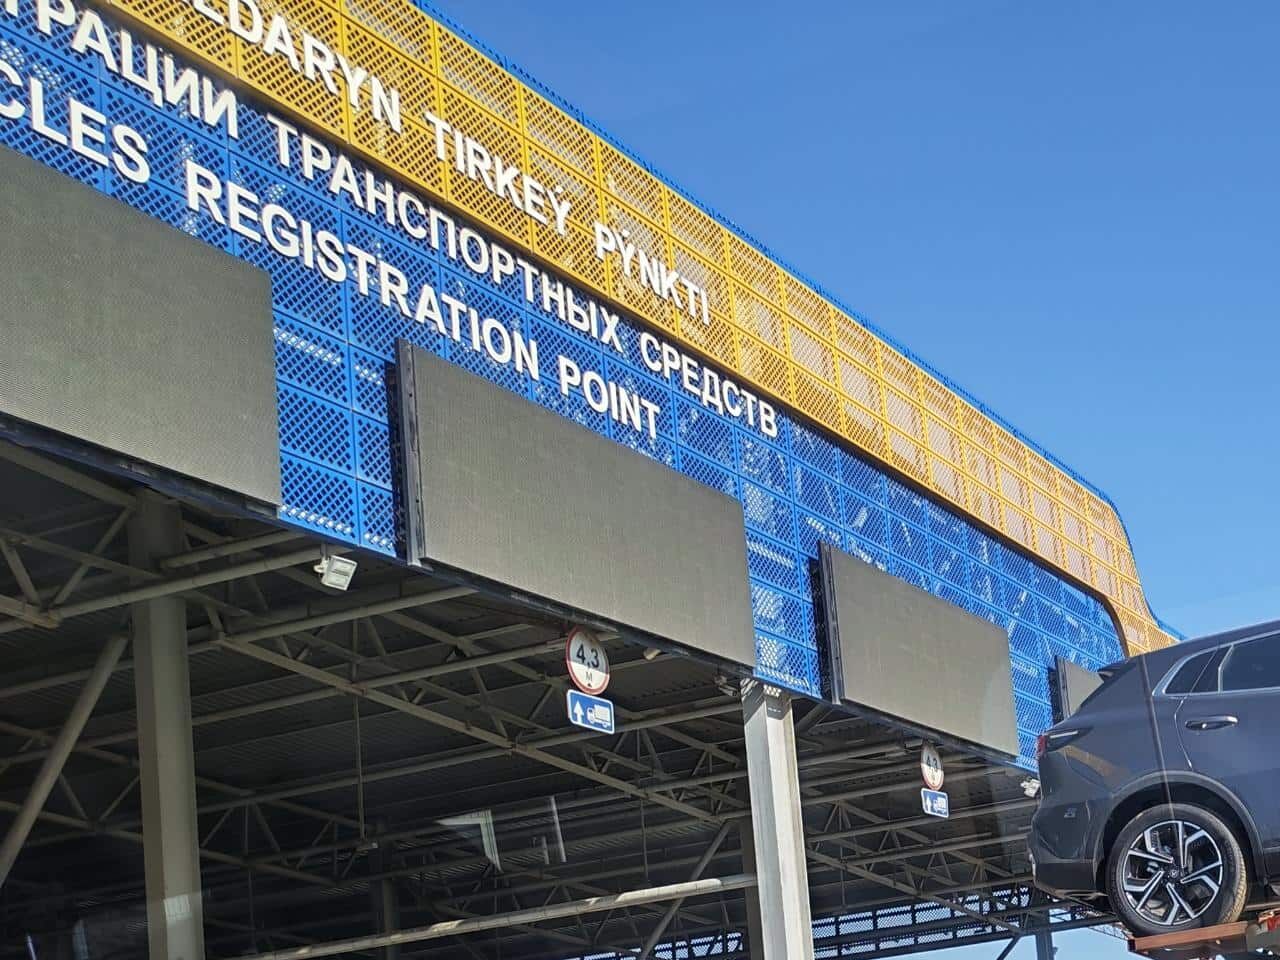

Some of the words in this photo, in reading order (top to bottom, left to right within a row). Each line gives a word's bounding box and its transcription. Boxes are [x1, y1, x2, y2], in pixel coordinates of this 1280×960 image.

[193, 0, 401, 134] DARYN
[425, 112, 571, 236] TIRKEÝ
[186, 159, 539, 381] REGISTRATION
[558, 355, 660, 439] POINT
[266, 113, 624, 352] ТРАНСПОРТНЫХ
[640, 333, 778, 438] СРЕДСТВ
